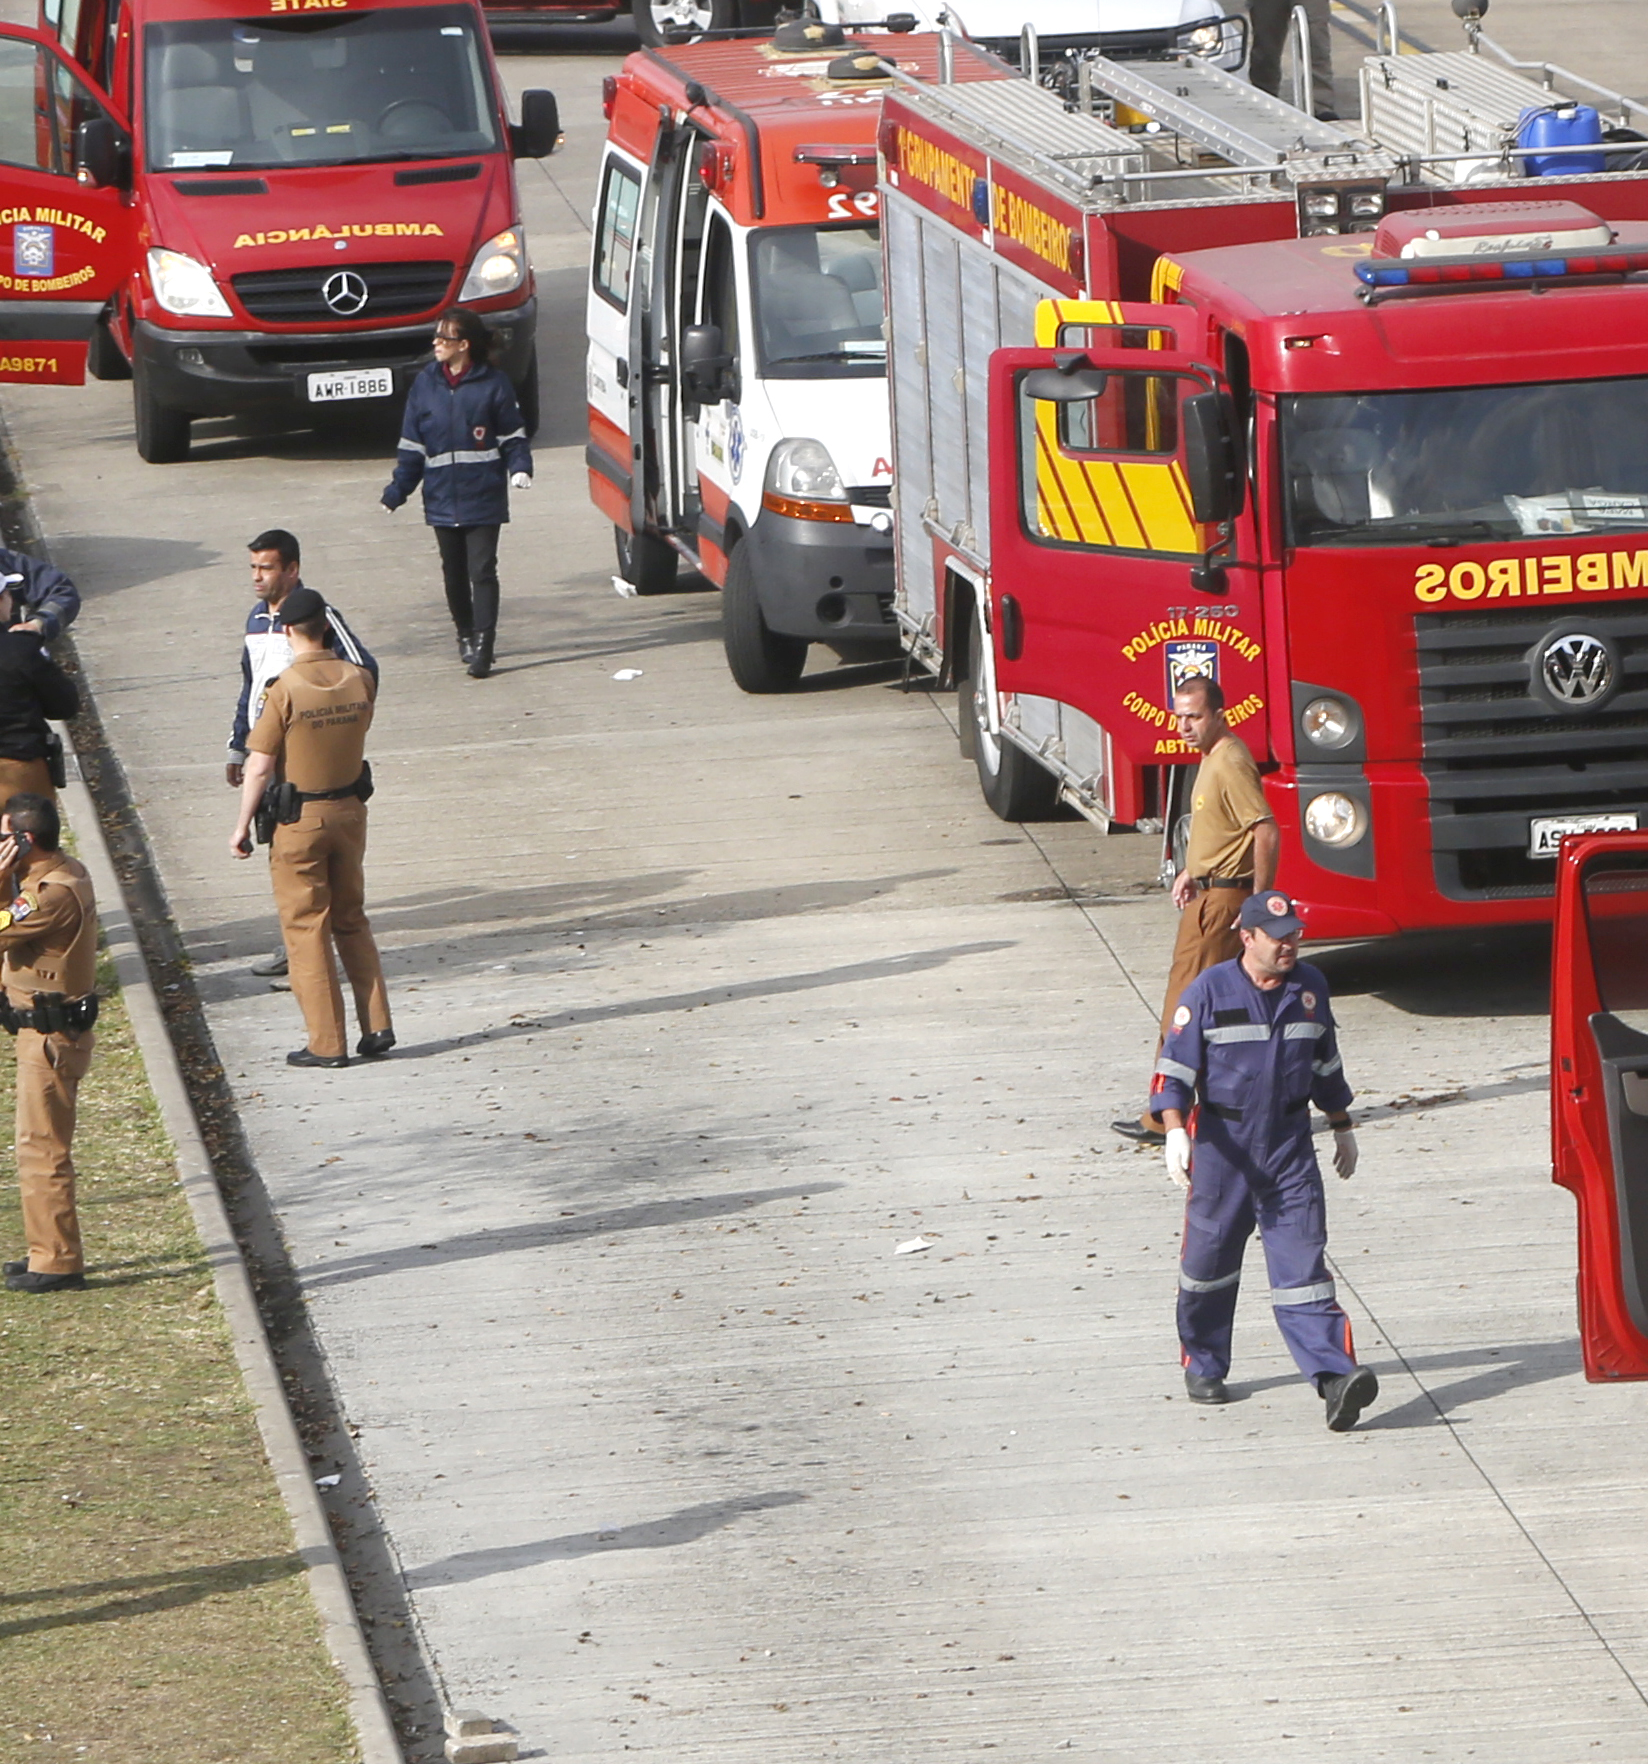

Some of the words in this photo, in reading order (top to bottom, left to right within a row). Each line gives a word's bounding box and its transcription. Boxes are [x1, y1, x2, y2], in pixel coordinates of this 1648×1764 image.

[36, 207, 107, 244] MILITAR
[993, 181, 1007, 231] DE
[14, 279, 30, 292] DE
[32, 265, 96, 292] BOMBEIROS
[1167, 604, 1240, 619] 17-250
[1121, 618, 1189, 662] POLÍCIA
[1194, 618, 1262, 663] MILITAR
[1122, 691, 1166, 727] CORPO
[1167, 716, 1180, 733] D
[1224, 693, 1264, 727] EIROS
